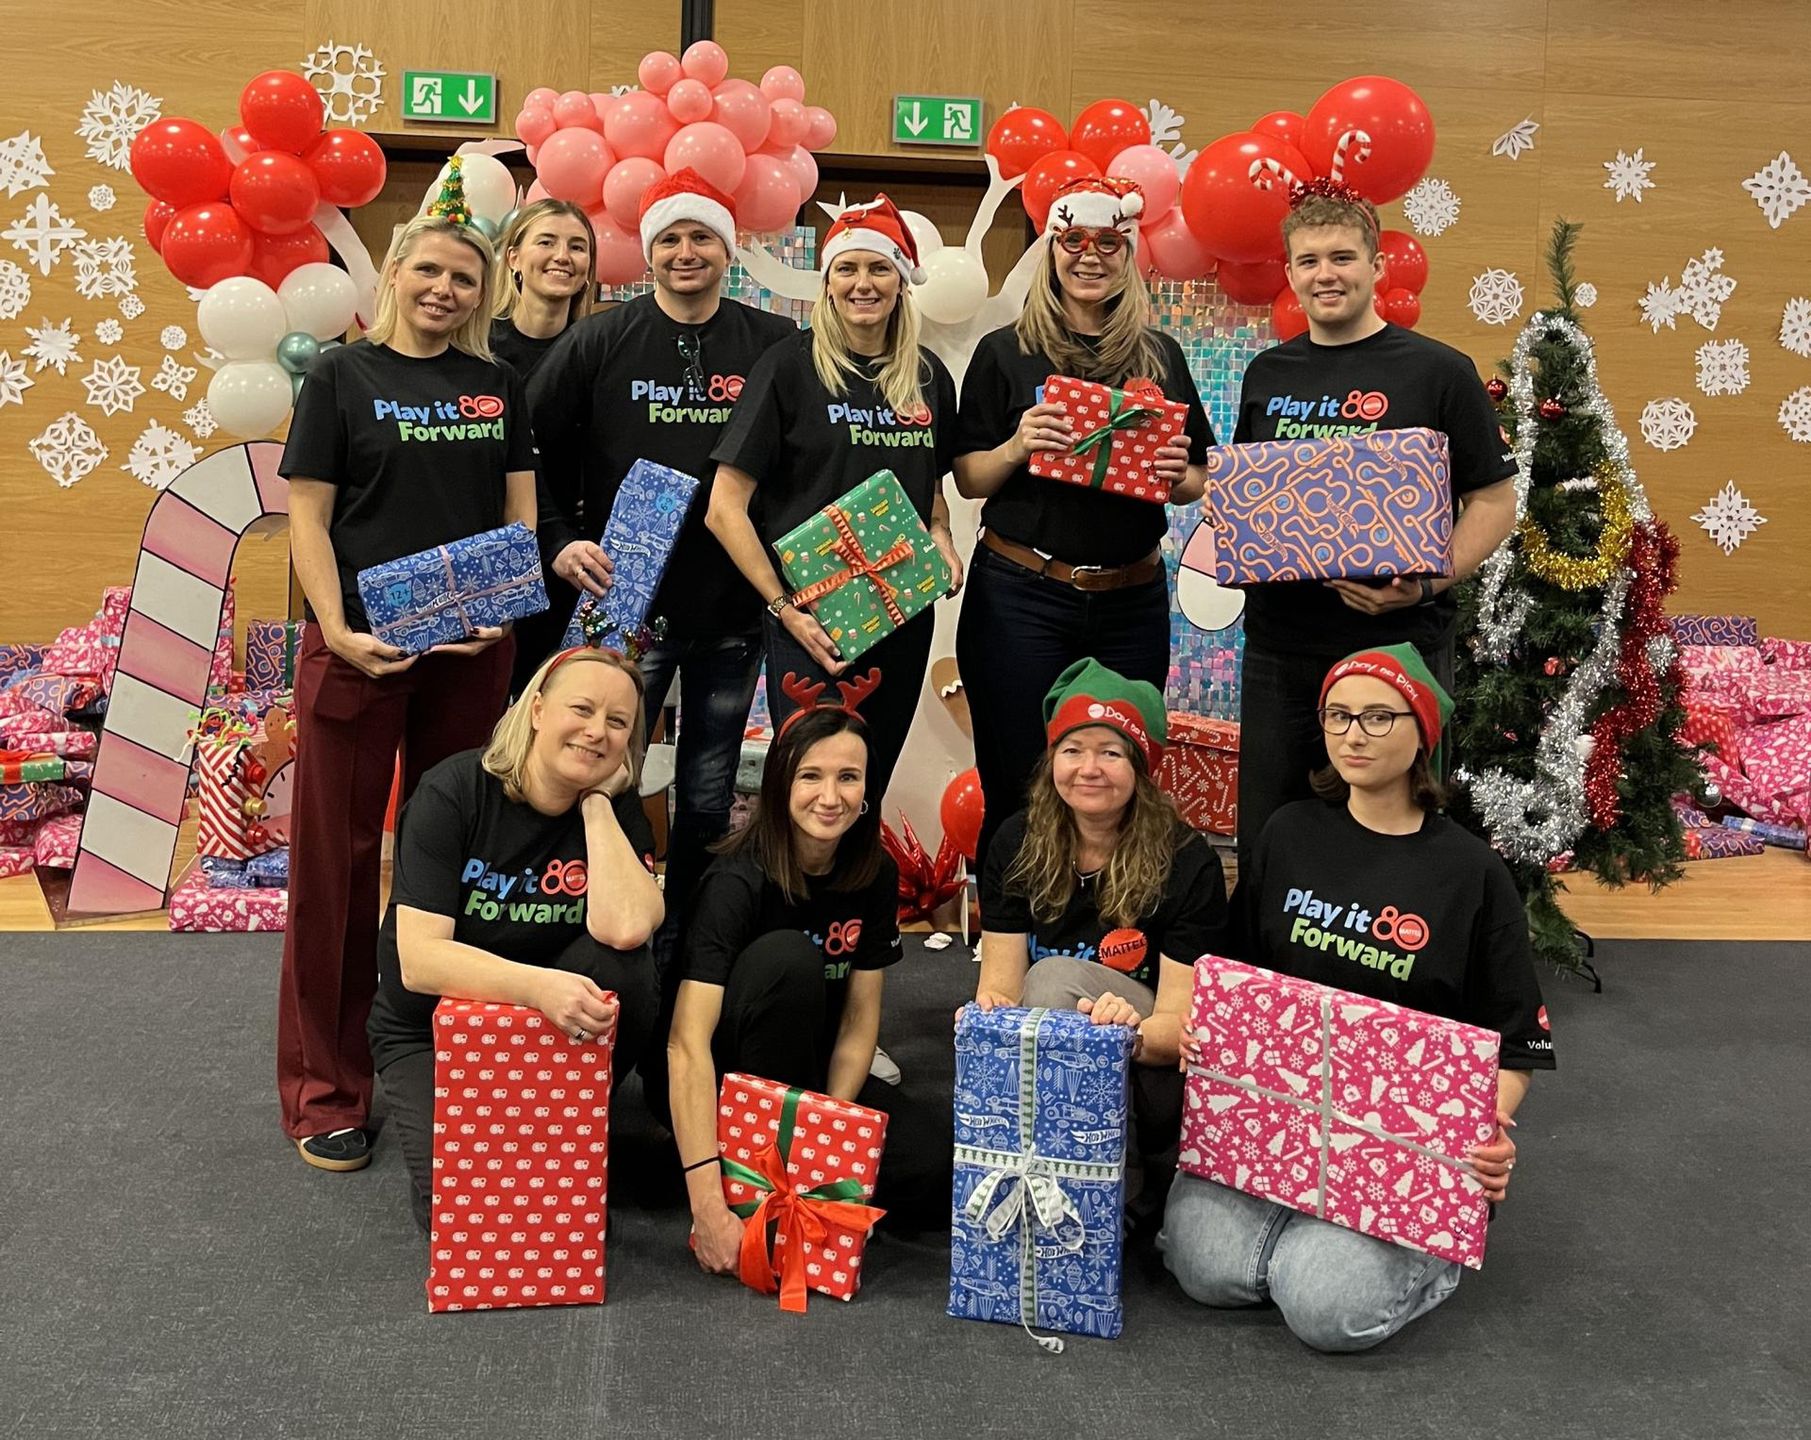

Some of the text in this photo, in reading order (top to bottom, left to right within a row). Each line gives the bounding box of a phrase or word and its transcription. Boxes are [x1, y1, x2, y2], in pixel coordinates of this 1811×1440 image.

[631, 380, 683, 406] Play
[1266, 389, 1389, 421] Play it 80
[373, 399, 430, 425] Play
[434, 401, 460, 420] it
[458, 395, 504, 418] 80
[649, 403, 733, 423] Forwar
[827, 402, 873, 428] Play
[875, 405, 896, 425] it
[398, 417, 504, 442] Forward
[849, 424, 934, 448] Forward
[461, 857, 517, 899] Play
[1283, 888, 1430, 951] Play it 80
[1290, 917, 1416, 982] Forward
